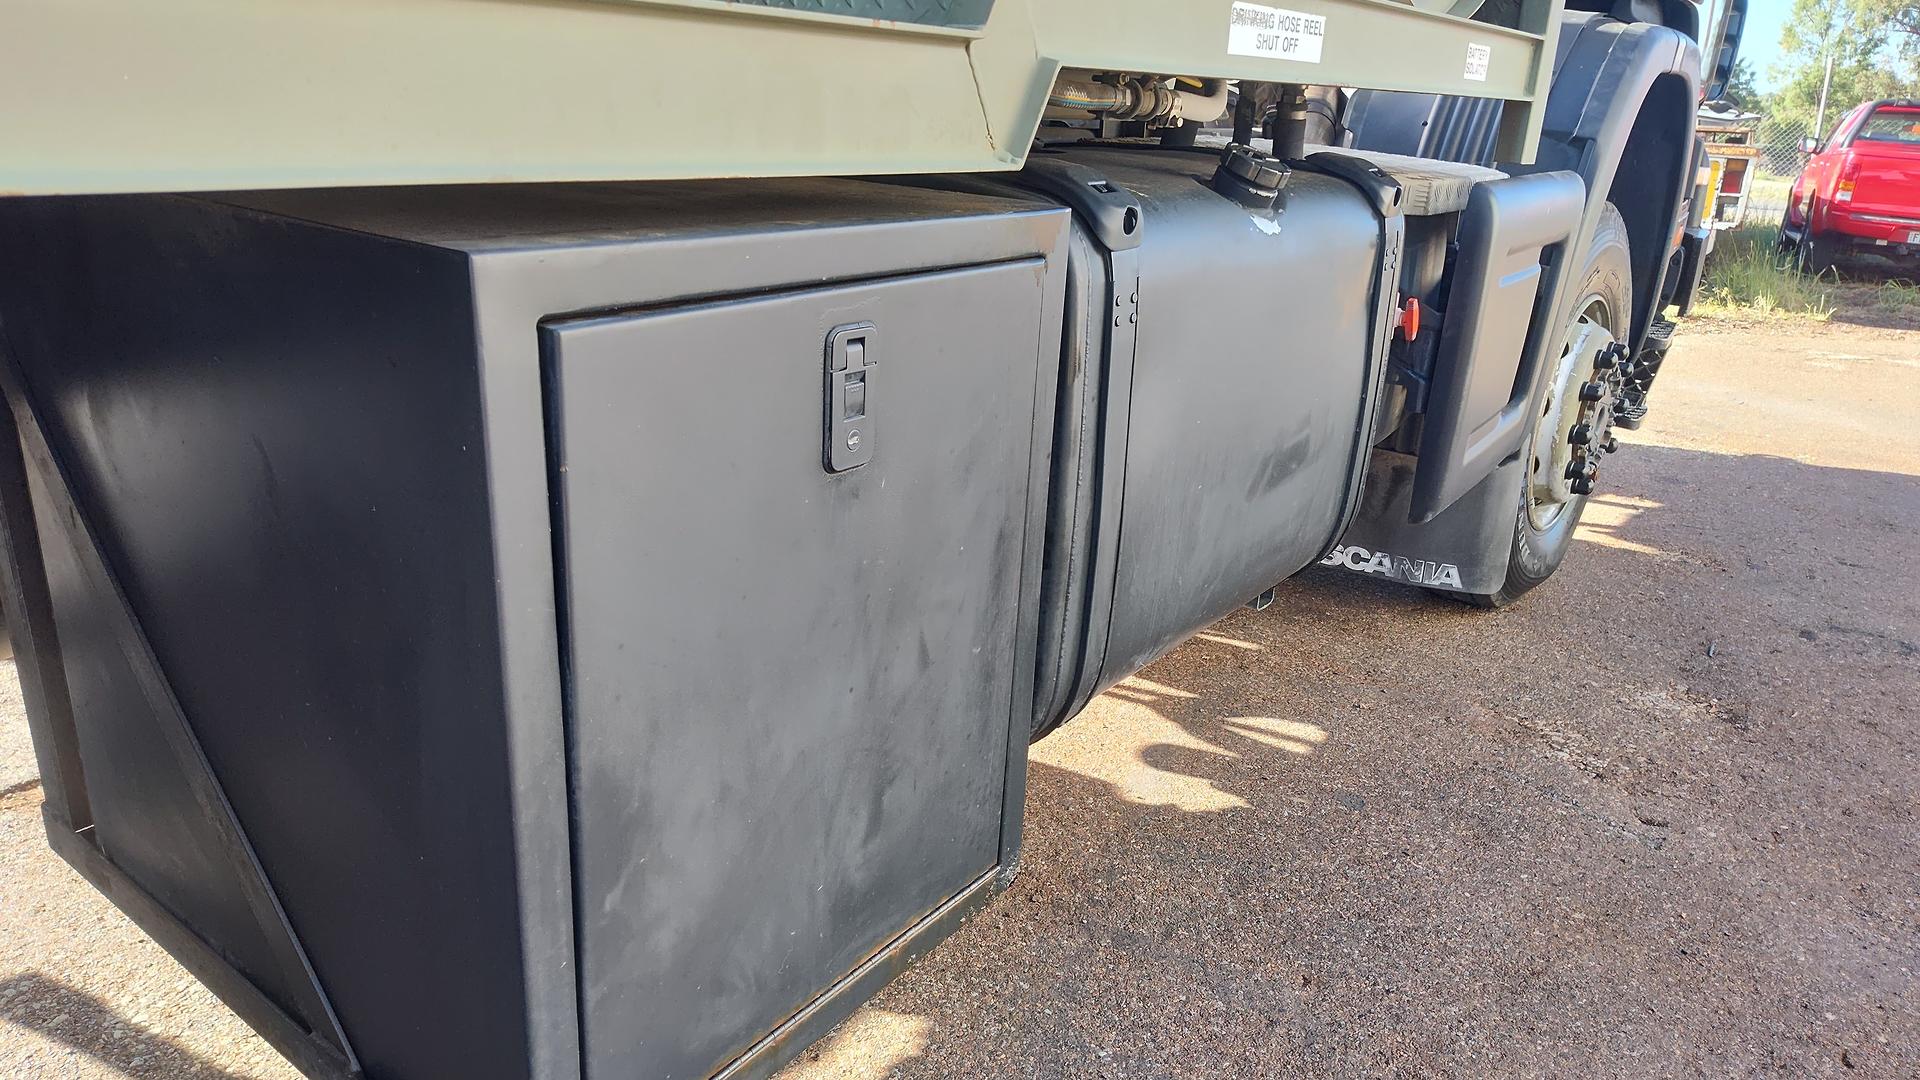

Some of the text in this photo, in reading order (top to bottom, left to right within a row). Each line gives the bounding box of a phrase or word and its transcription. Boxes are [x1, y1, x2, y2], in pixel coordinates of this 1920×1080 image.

[1278, 14, 1302, 33] HOSE
[1303, 18, 1323, 36] REEL
[1256, 33, 1299, 53] SHUT OFF
